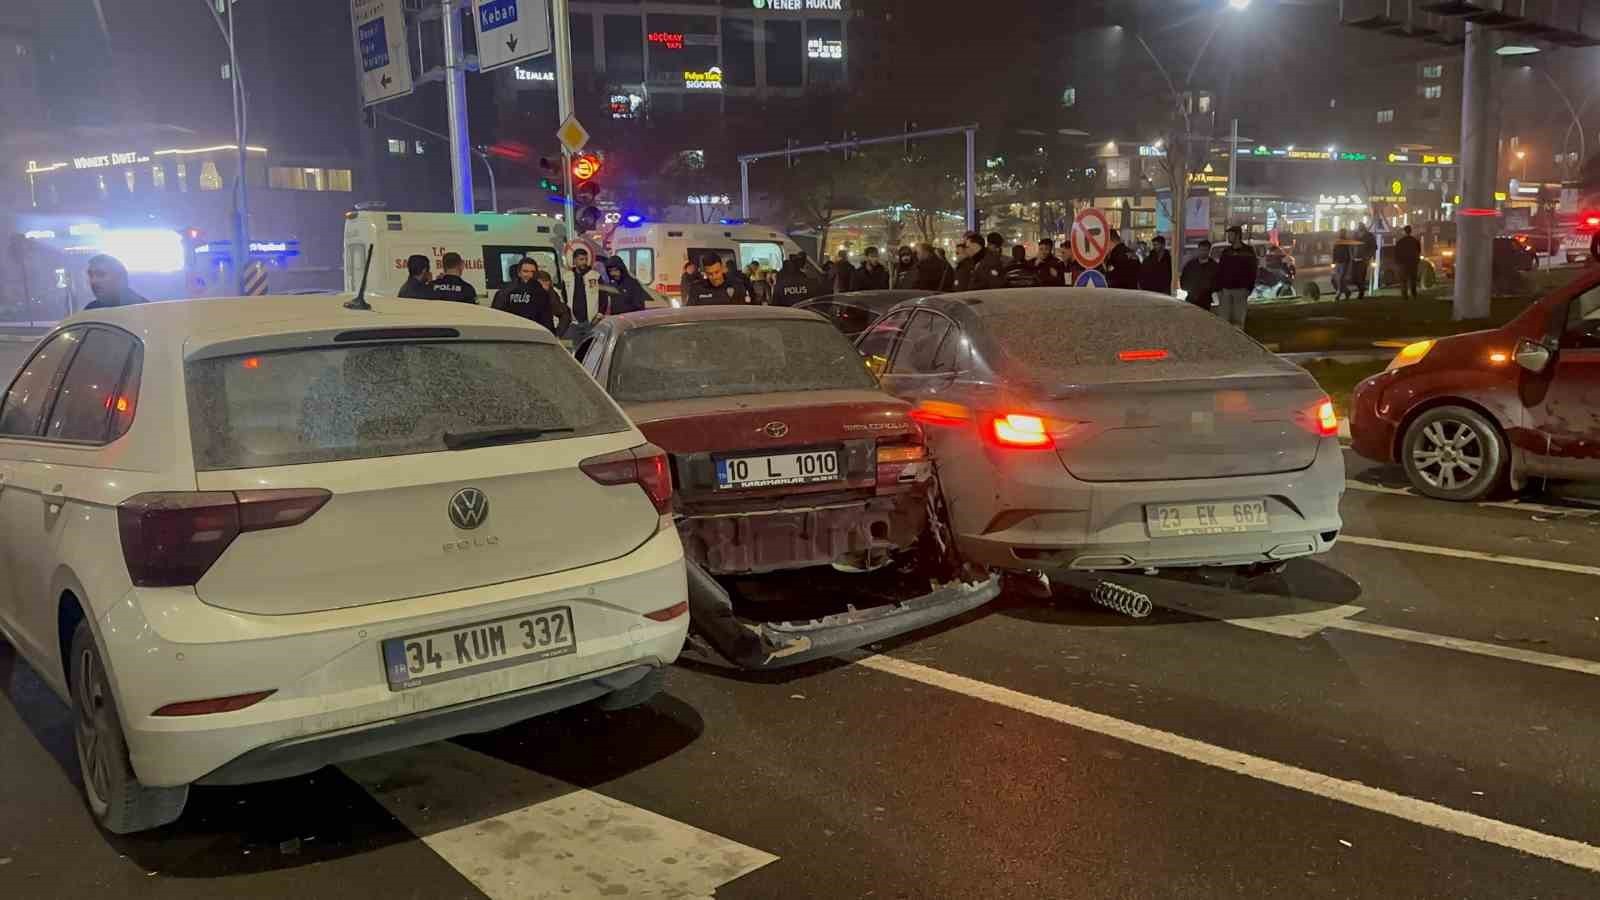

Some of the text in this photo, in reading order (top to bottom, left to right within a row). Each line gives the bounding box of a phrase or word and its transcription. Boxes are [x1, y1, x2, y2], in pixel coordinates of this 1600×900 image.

[481, 4, 515, 25] Keban
[767, 0, 842, 10] YENER HUKUK
[728, 452, 837, 480] 10 L 1010
[1159, 502, 1265, 528] 23 EK 662
[405, 613, 568, 675] 34 KUM 332
